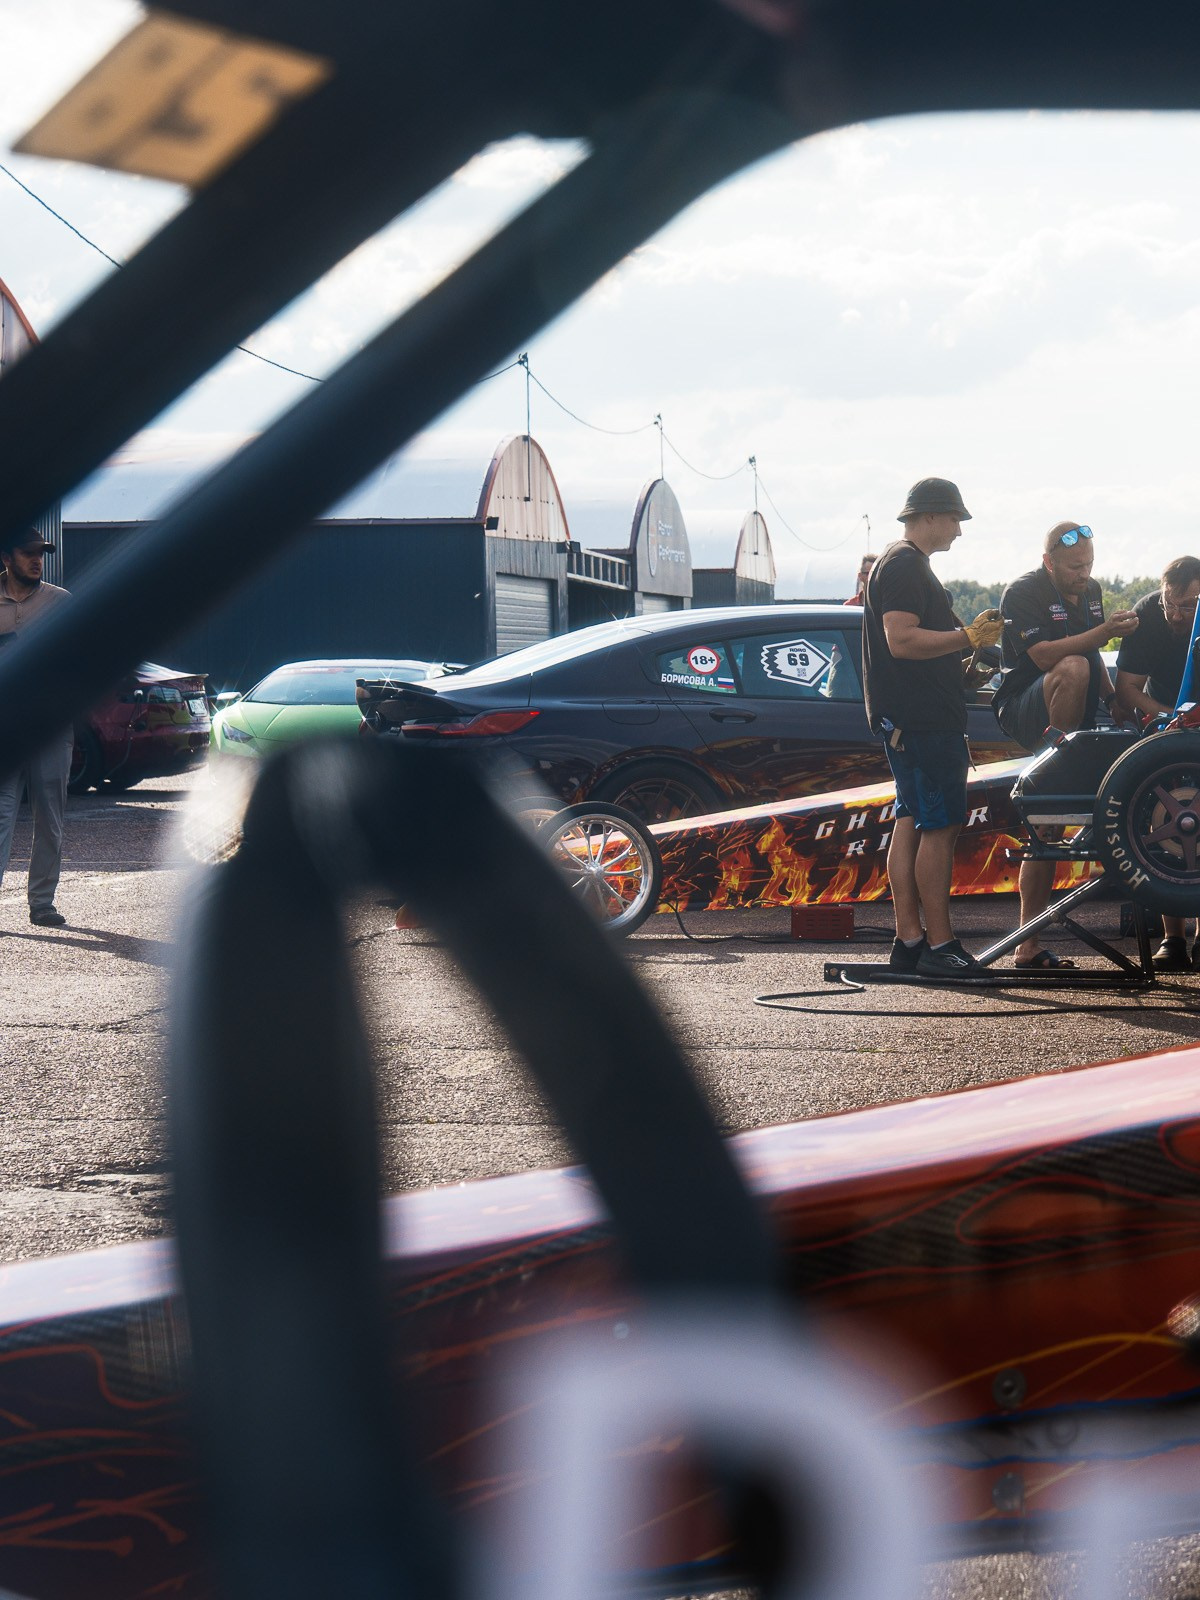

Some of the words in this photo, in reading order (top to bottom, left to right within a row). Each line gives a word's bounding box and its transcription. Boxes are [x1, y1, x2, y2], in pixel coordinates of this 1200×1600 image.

[691, 655, 716, 665] 18+
[787, 653, 810, 667] 69
[661, 673, 706, 686] БОРИСОВА
[814, 803, 896, 841] GHO
[1105, 795, 1150, 890] Hoosier
